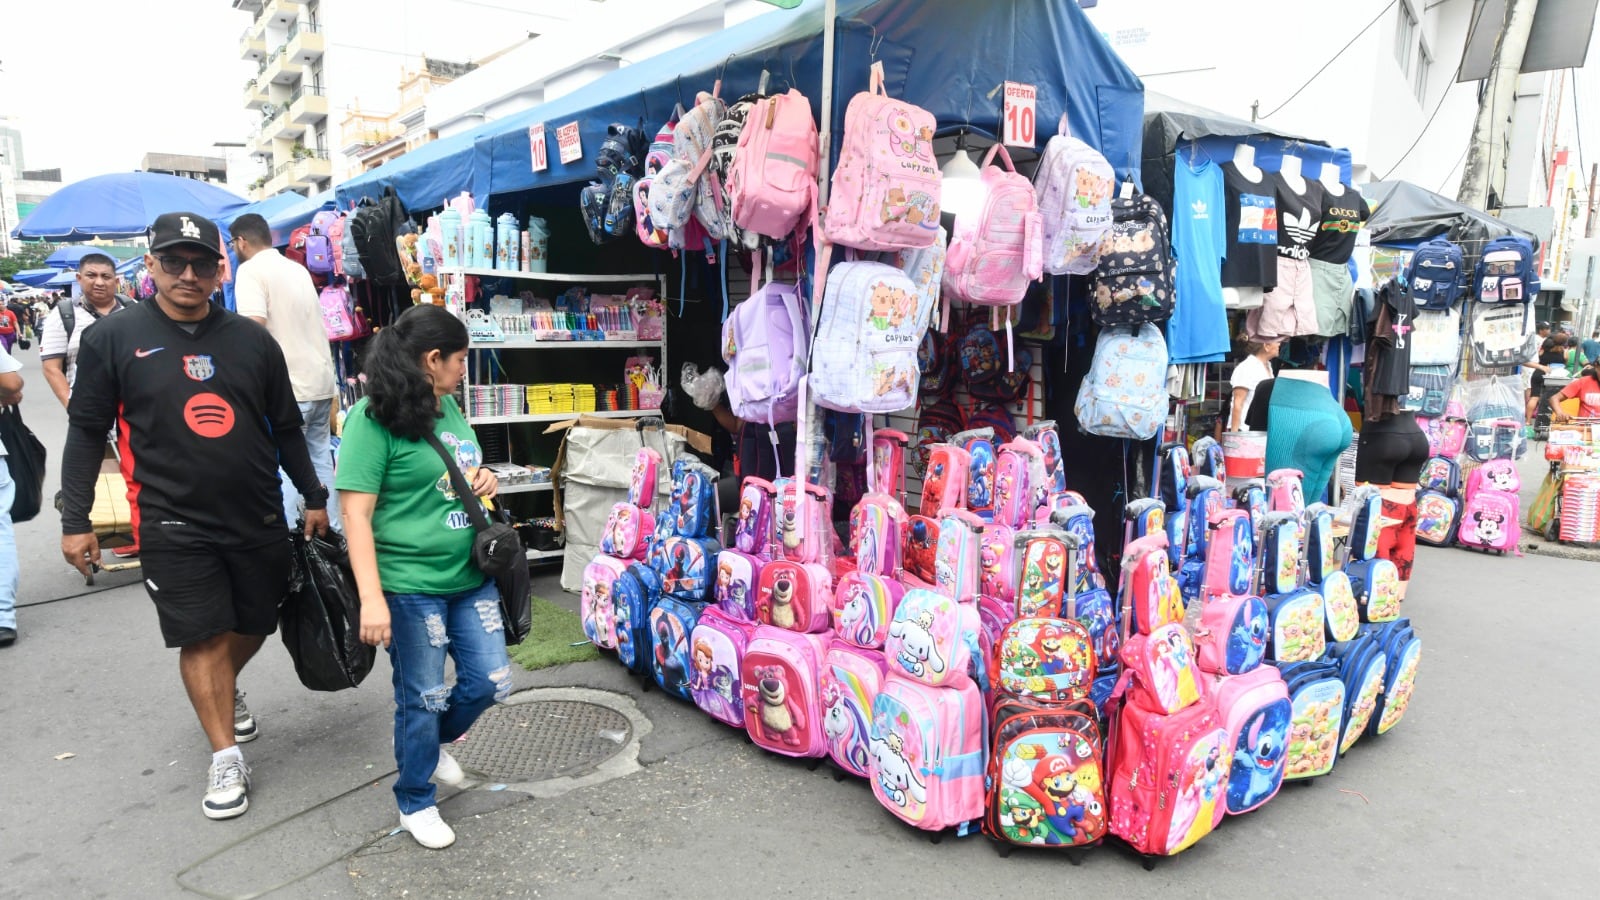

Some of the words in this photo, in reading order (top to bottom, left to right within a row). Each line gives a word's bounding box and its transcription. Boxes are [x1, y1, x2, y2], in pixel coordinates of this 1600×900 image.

[1006, 87, 1035, 99] OFERTA
[1329, 207, 1358, 218] GUCCI
[180, 216, 201, 239] LA
[1277, 244, 1310, 260] adid
